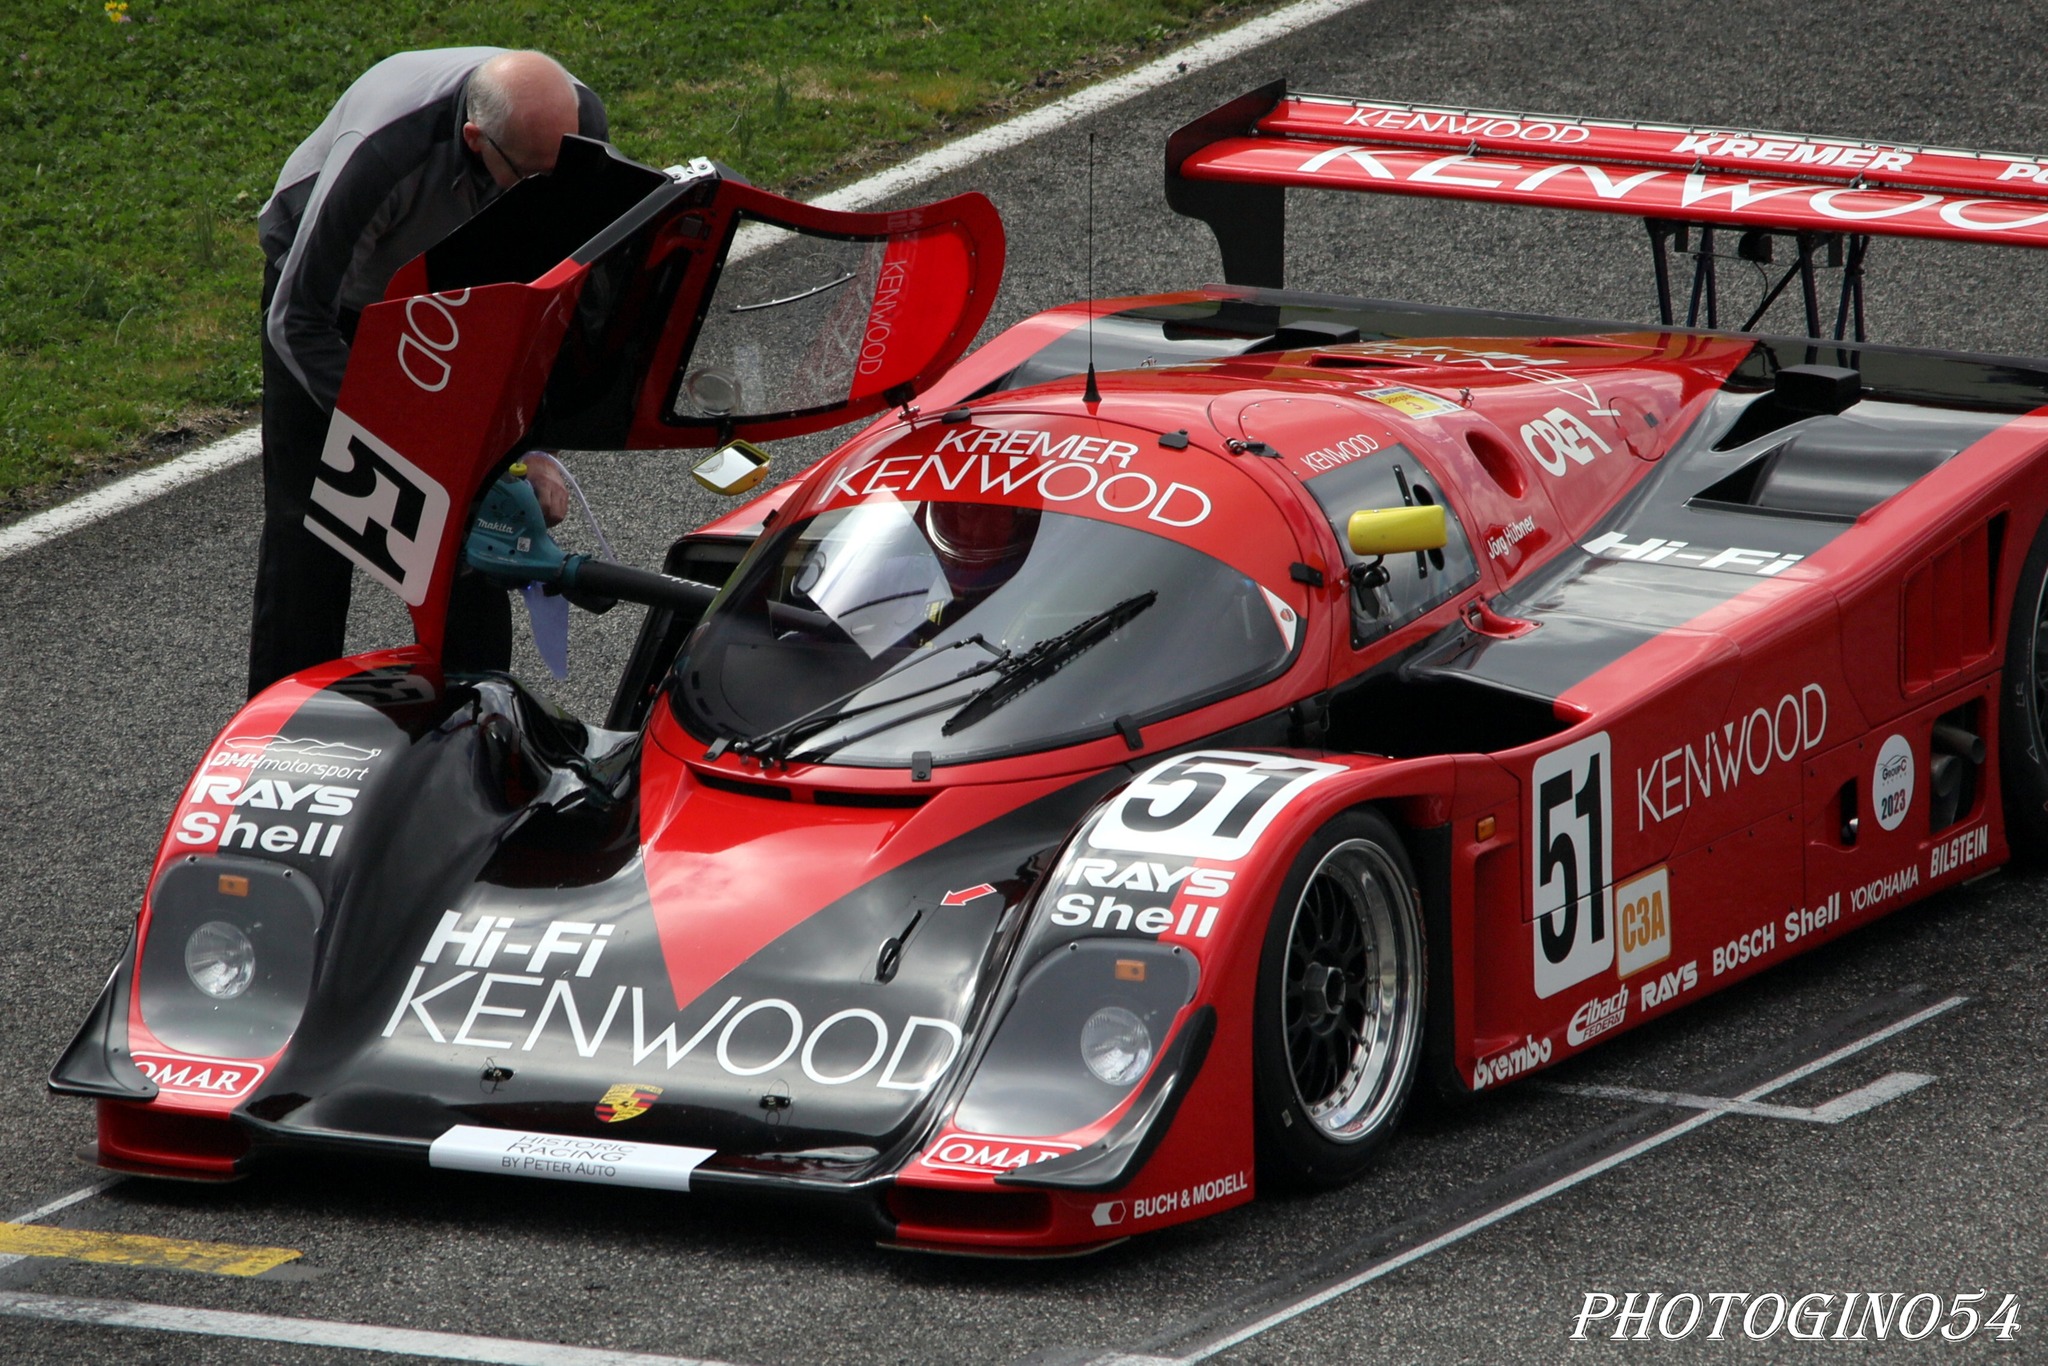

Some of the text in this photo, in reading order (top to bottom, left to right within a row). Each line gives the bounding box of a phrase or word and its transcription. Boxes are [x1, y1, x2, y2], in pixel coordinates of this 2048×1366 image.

[1343, 108, 1590, 144] KENWOOD
[1671, 135, 1914, 172] KREMER
[398, 287, 471, 392] OD
[859, 260, 907, 375] KENWOOD
[935, 429, 1140, 469] KREMER
[1300, 433, 1379, 473] KENWOOD
[306, 434, 427, 586] 51
[818, 454, 1212, 527] KENWOOD
[1487, 514, 1537, 560] Jörg Hübner
[1581, 531, 1805, 576] Hi-Fi
[1637, 682, 1827, 832] KENWOOD
[190, 775, 360, 816] RAYS
[1121, 756, 1320, 839] 51
[1881, 789, 1906, 821] 2023
[176, 811, 344, 857] Shell
[1540, 752, 1605, 965] 51
[1930, 824, 1988, 879] BILSTEIN
[1065, 857, 1238, 898] RAYS
[1850, 864, 1919, 912] YOKOHAMA
[1050, 894, 1221, 938] Shell
[1622, 890, 1666, 953] C3A
[1784, 891, 1840, 942] Shell
[421, 910, 615, 978] Hi-Fi
[1712, 921, 1775, 977] BOSCH
[1640, 960, 1698, 1012] RAYS
[381, 966, 964, 1092] KENWOOD
[1567, 983, 1629, 1047] Eibach
[1583, 1013, 1623, 1041] FEDERN
[1473, 1034, 1552, 1091] brembo
[501, 1157, 520, 1169] BY
[506, 1142, 626, 1162] RACING
[519, 1135, 638, 1153] HISTORIC
[1133, 1171, 1248, 1219] BUCH & MODELL
